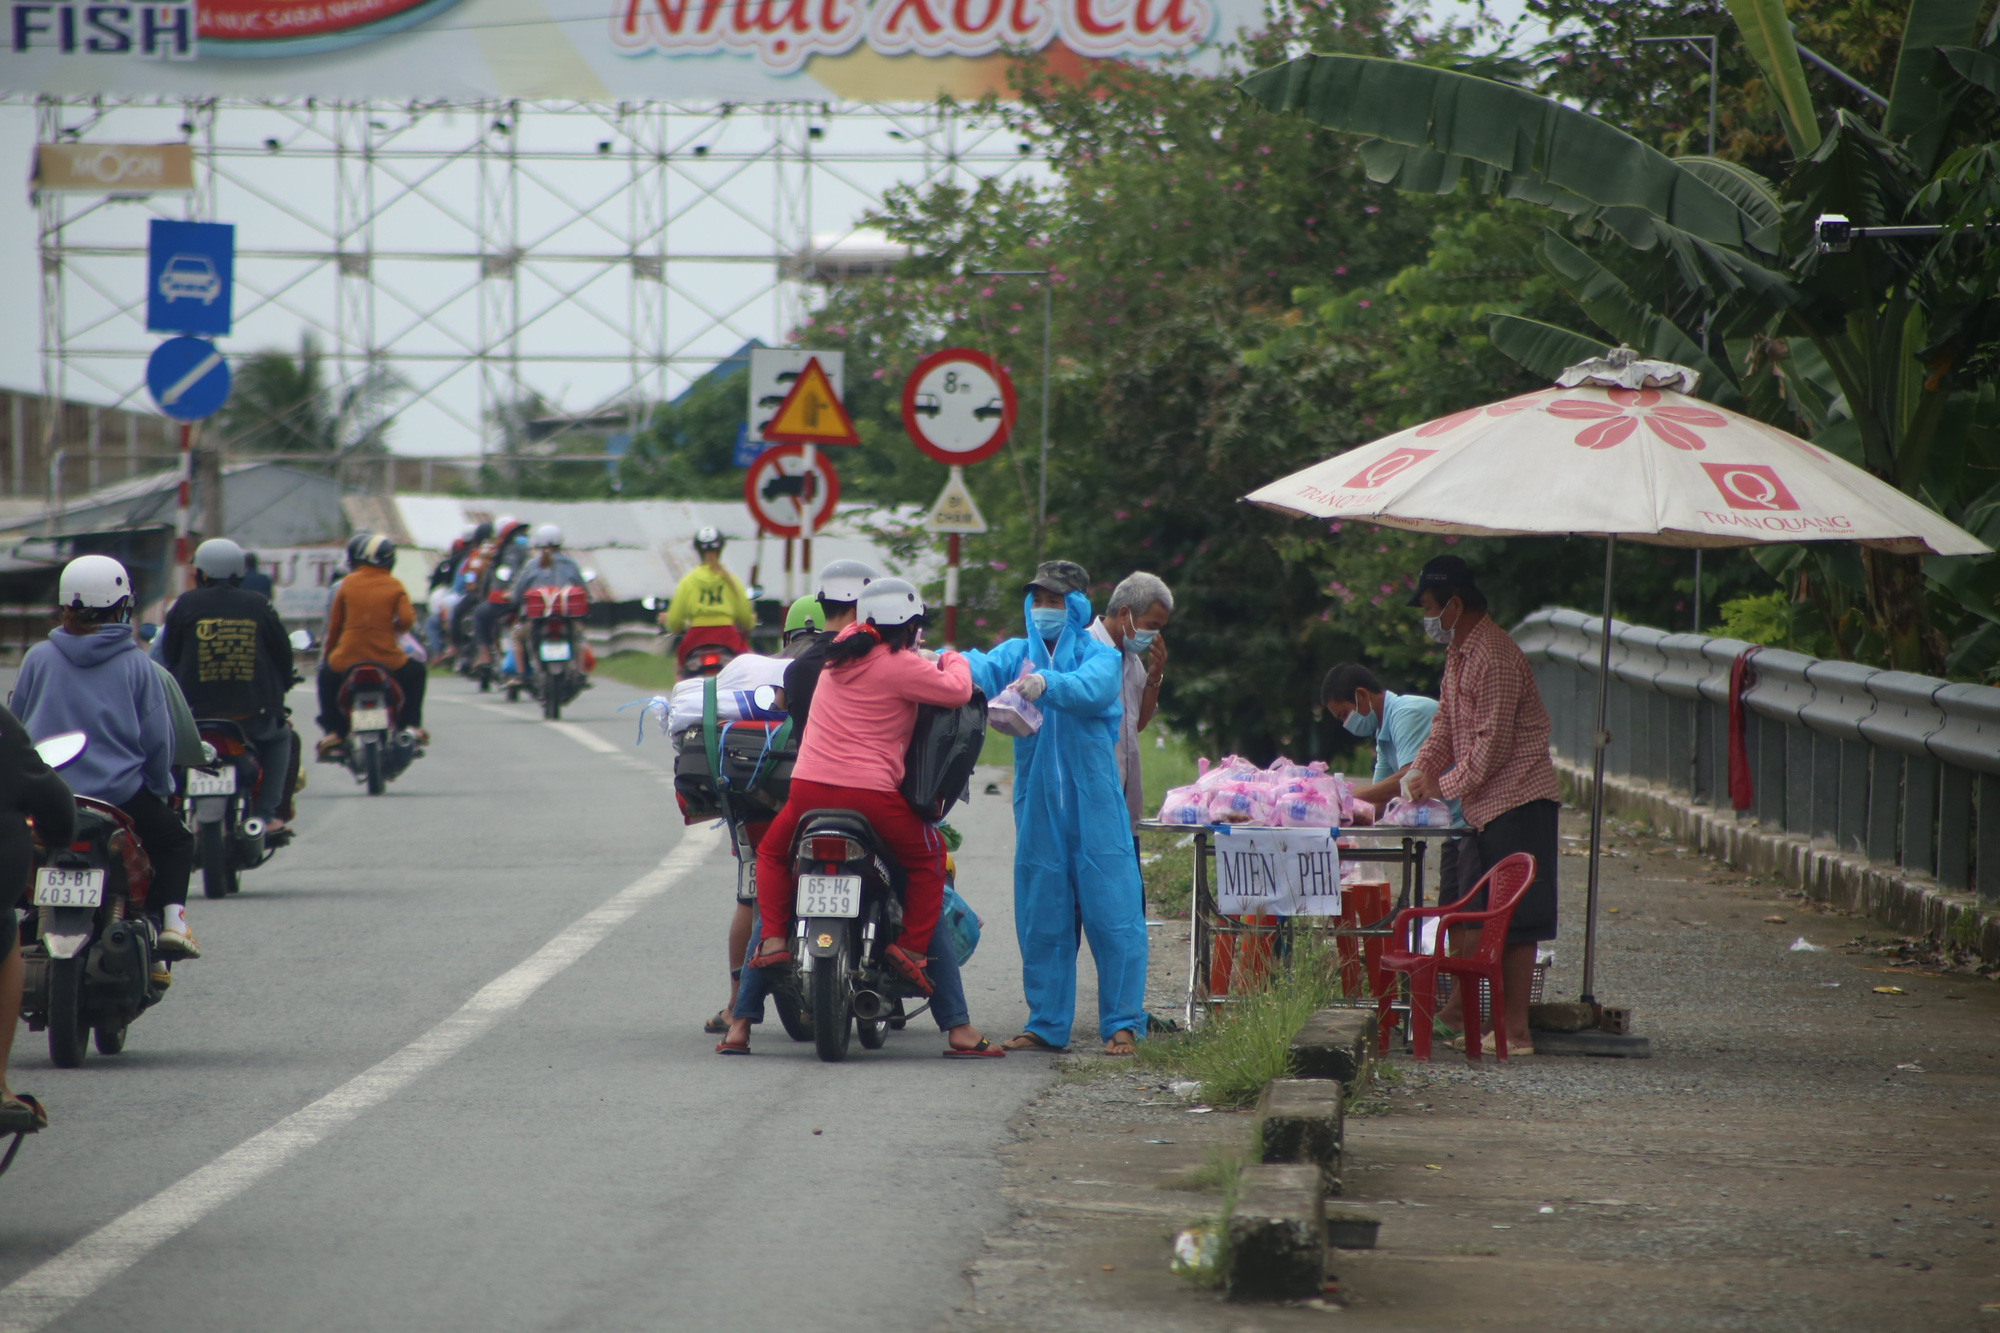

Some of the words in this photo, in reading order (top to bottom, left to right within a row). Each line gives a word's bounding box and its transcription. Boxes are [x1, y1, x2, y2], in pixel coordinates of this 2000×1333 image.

[12, 6, 190, 54] FISH
[1723, 471, 1780, 509] Q
[48, 871, 91, 887] 63-B1
[808, 878, 851, 895] 65-H4
[39, 887, 97, 904] 403.12
[806, 896, 850, 914] 2559
